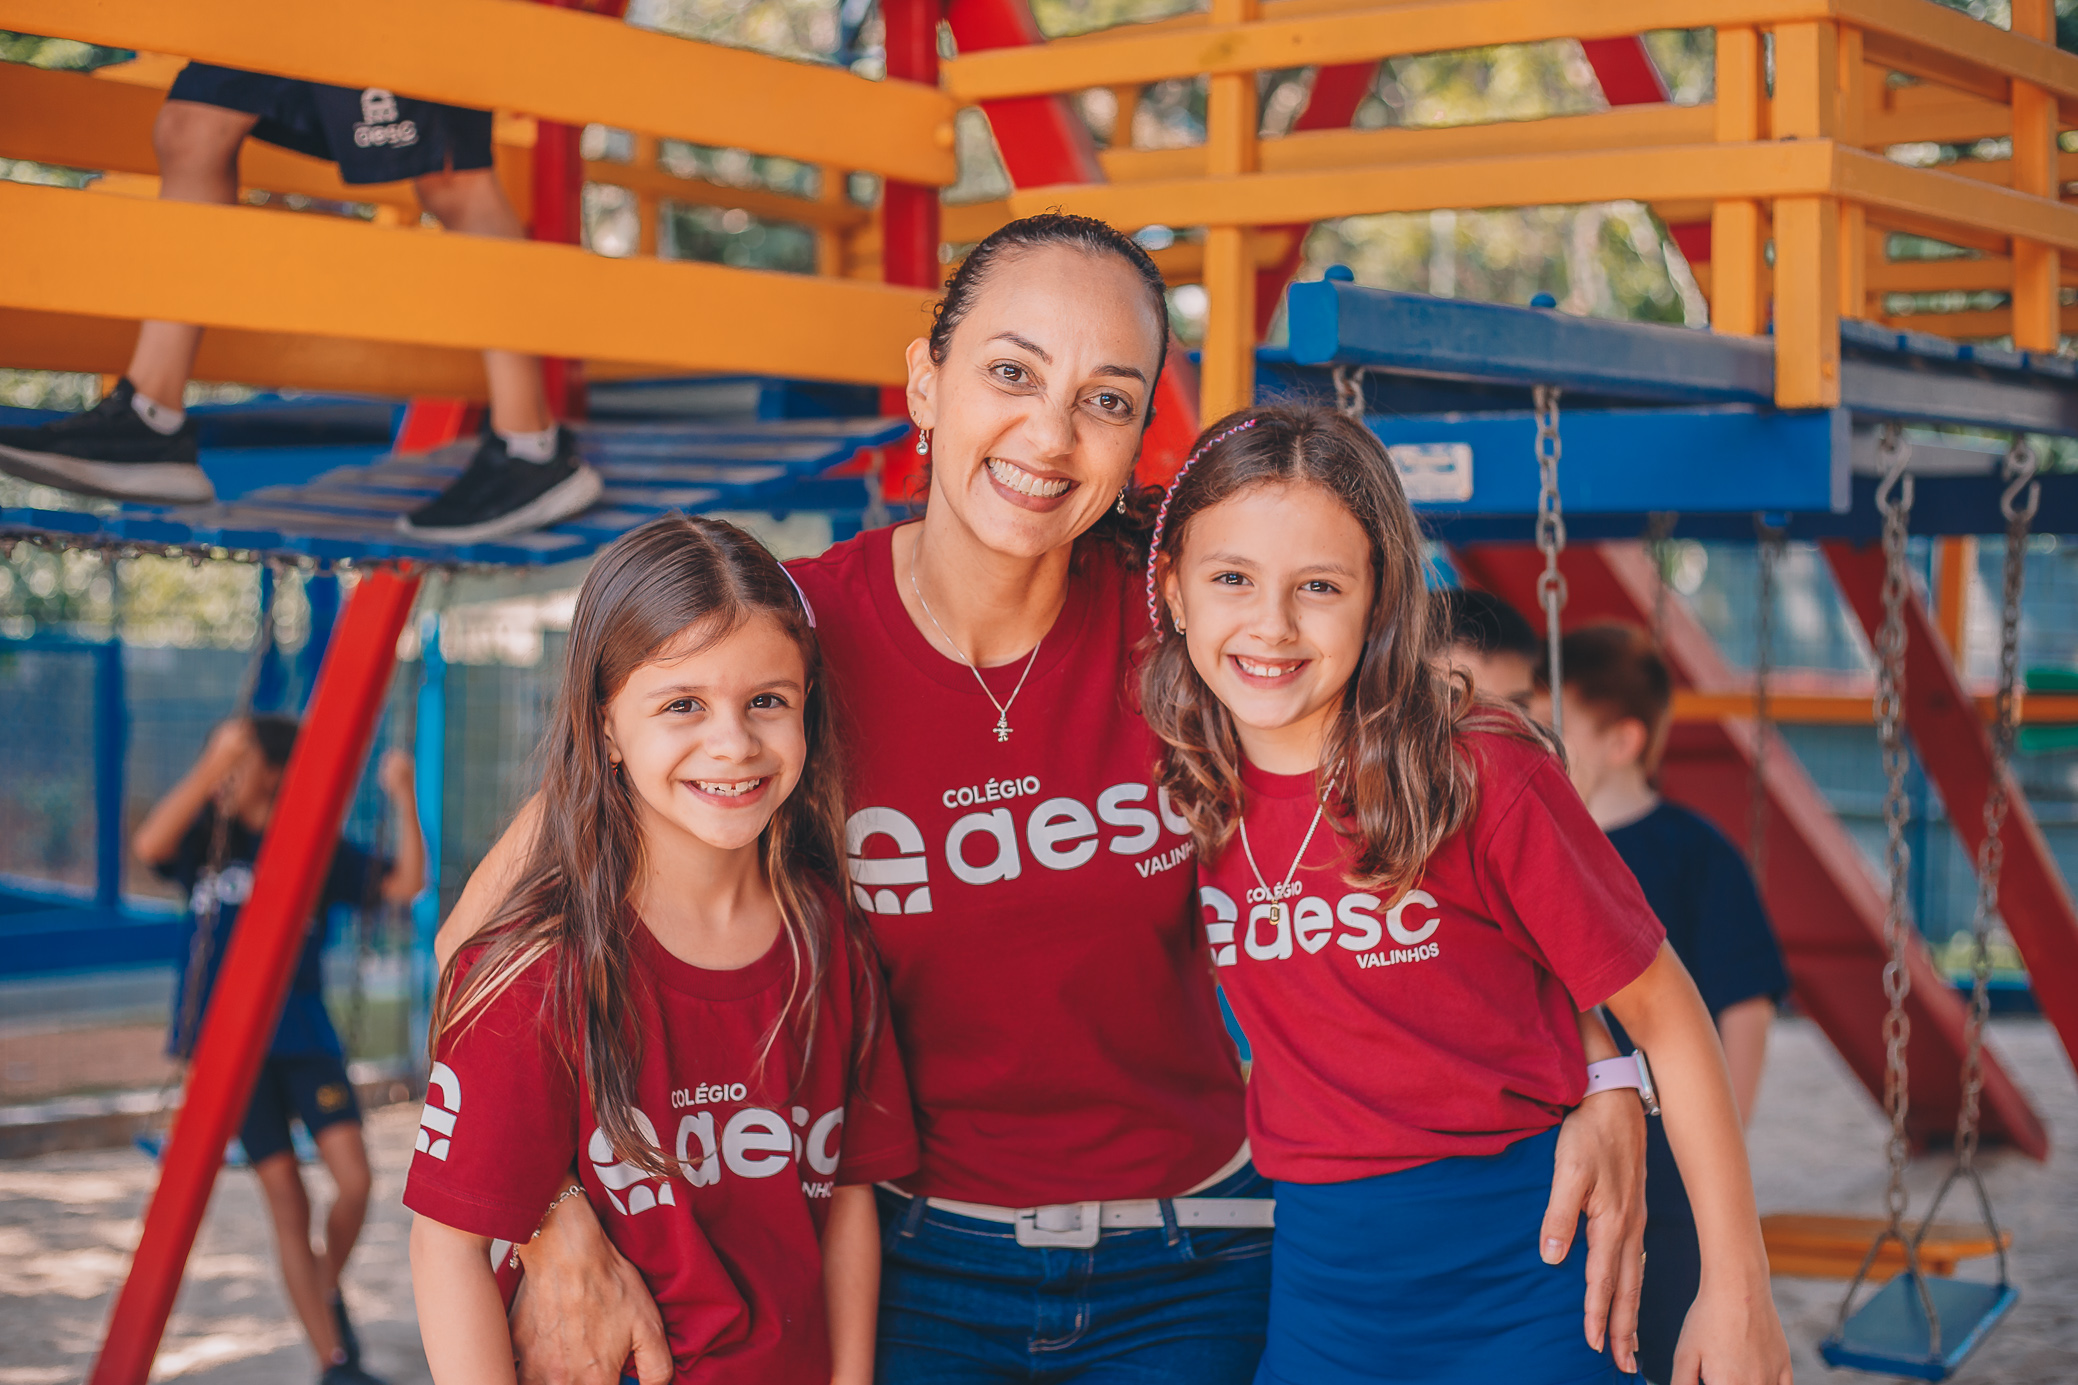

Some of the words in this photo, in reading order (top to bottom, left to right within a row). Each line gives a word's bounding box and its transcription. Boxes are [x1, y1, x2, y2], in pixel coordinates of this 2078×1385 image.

[942, 775, 1041, 809] COLÉGIO
[1134, 841, 1195, 879] VALINH
[1244, 889, 1440, 960] aesc
[1355, 942, 1440, 970] VALINHOS
[671, 1082, 748, 1109] COLÉGIO
